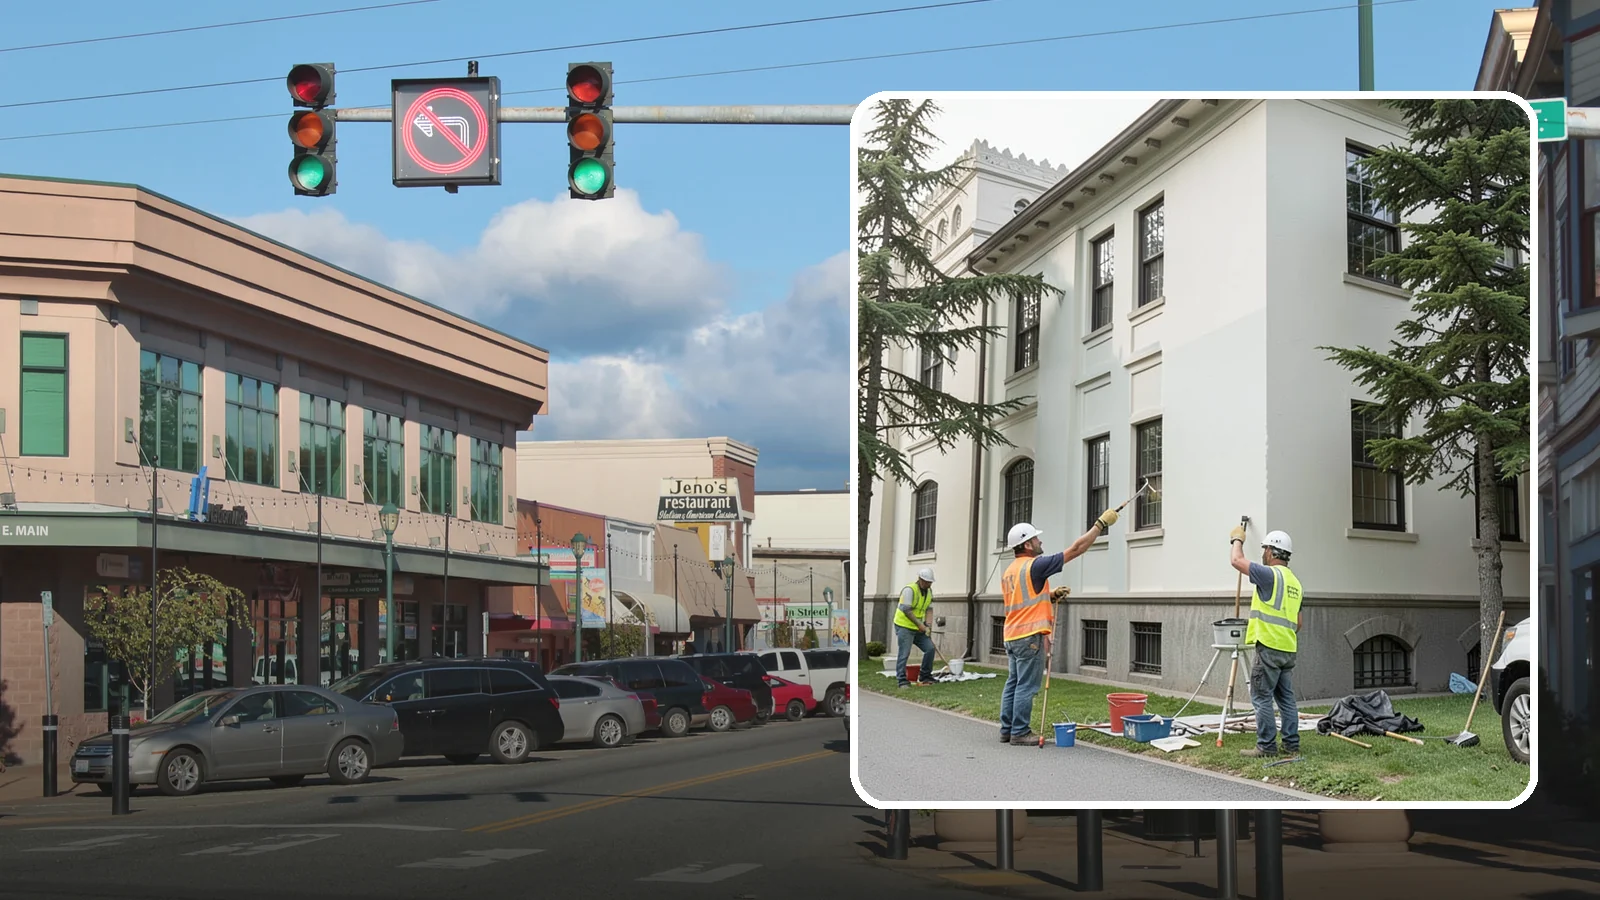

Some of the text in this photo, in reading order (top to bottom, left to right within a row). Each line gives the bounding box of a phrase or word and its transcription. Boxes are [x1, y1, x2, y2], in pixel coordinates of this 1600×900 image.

[669, 480, 728, 495] Jeno's
[665, 496, 731, 509] restaurant
[658, 510, 681, 519] Italian
[685, 509, 714, 519] American
[715, 509, 737, 519] Cuisine
[2, 525, 49, 536] E. MAIN
[797, 607, 828, 617] Street
